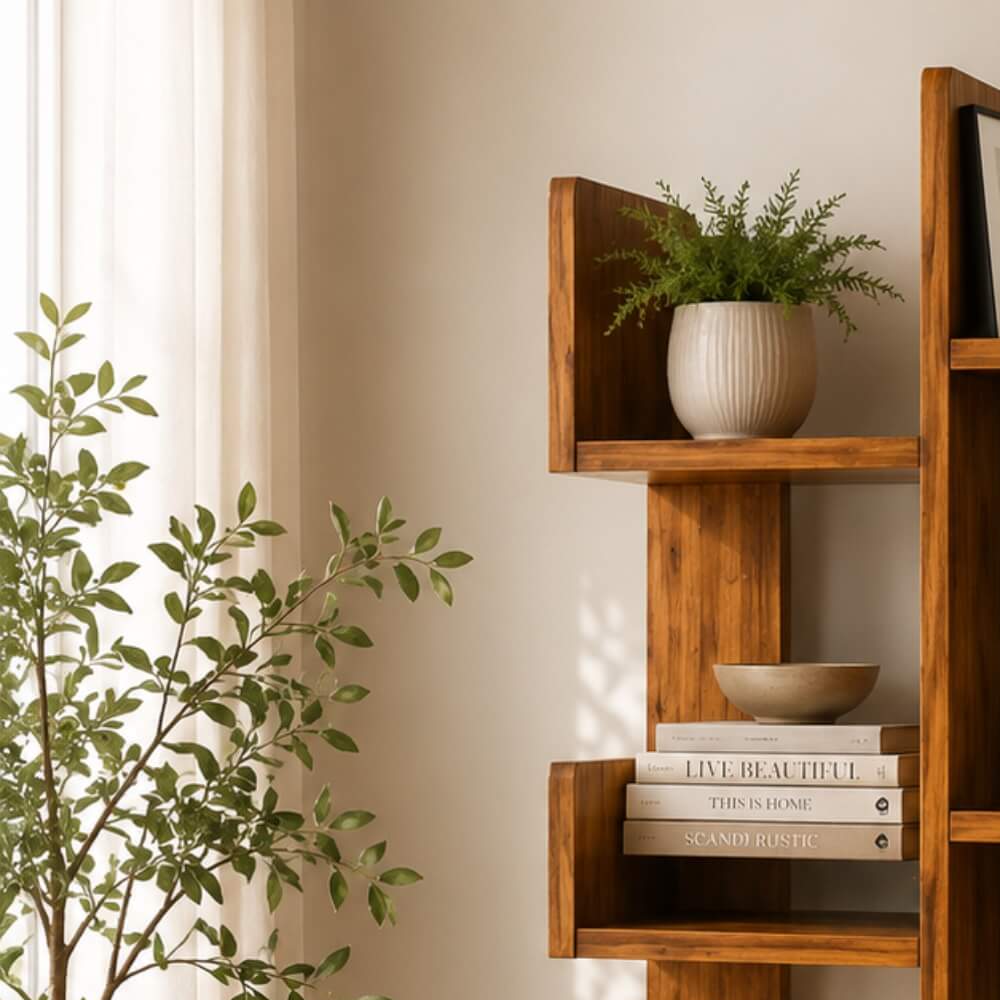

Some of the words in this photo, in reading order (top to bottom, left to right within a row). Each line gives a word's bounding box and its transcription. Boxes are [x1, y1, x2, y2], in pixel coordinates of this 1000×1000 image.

[685, 760, 734, 779] LIVE
[709, 796, 746, 810] THIS
[750, 797, 763, 810] IS
[766, 797, 813, 811] HOME
[684, 831, 750, 849] SCANDI
[755, 833, 819, 850] RUSTIC
